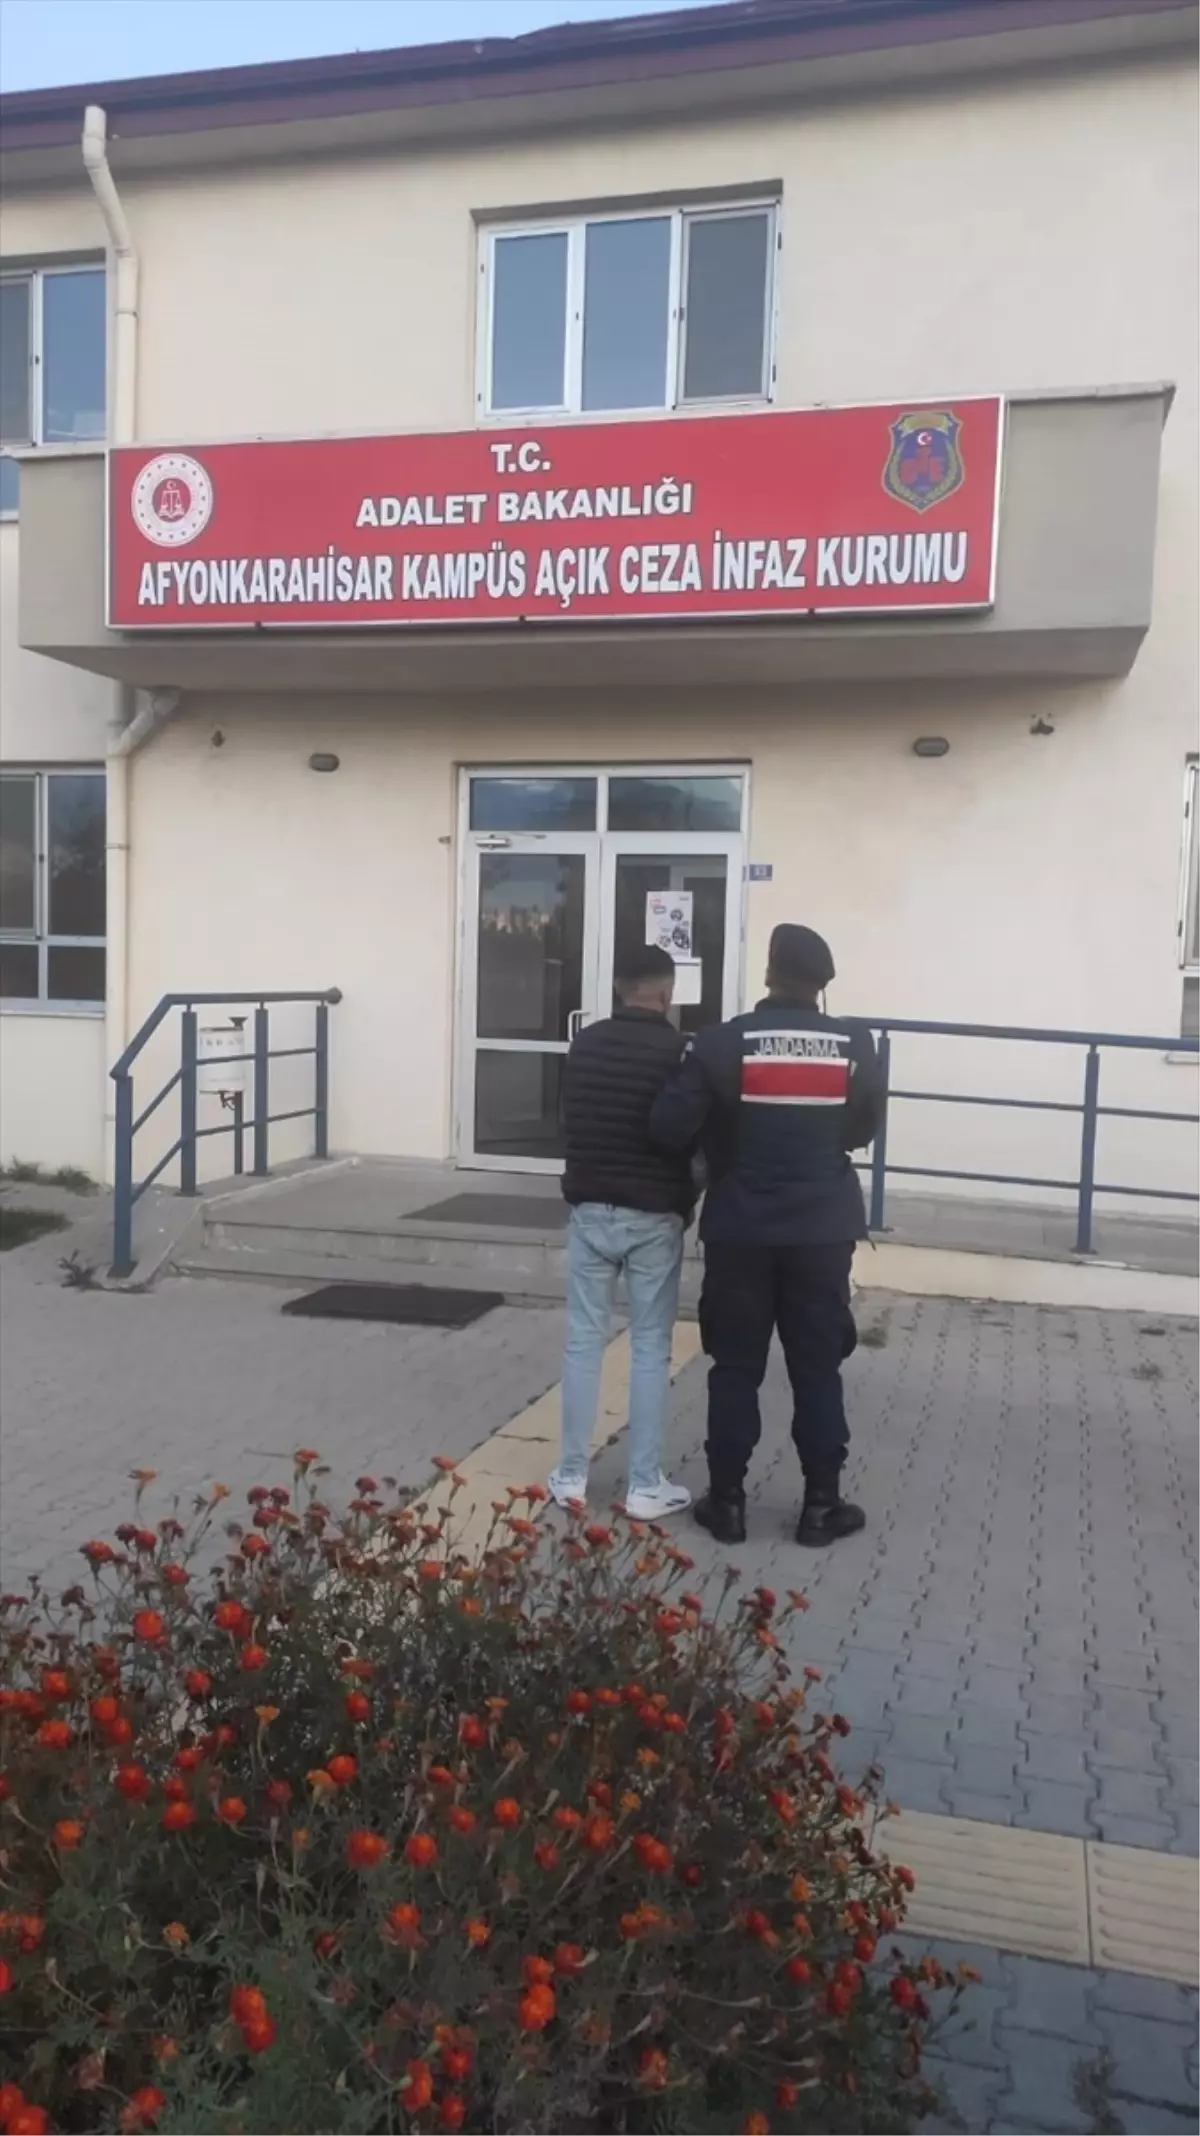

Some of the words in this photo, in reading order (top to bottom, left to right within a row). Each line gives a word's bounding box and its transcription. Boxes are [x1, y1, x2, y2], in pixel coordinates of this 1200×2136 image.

[490, 442, 552, 474] T.C.
[356, 495, 487, 527] ADALET
[498, 478, 692, 521] BAKANLIĞI
[138, 545, 394, 605] AFYONKARAHİSAR
[401, 541, 526, 600] KAMPÜS
[533, 544, 609, 609] AÇIK
[619, 543, 702, 593] CEZA
[712, 530, 808, 590] İNFAZ
[815, 531, 969, 588] KURUMU
[753, 1037, 841, 1058] JANDARMA
